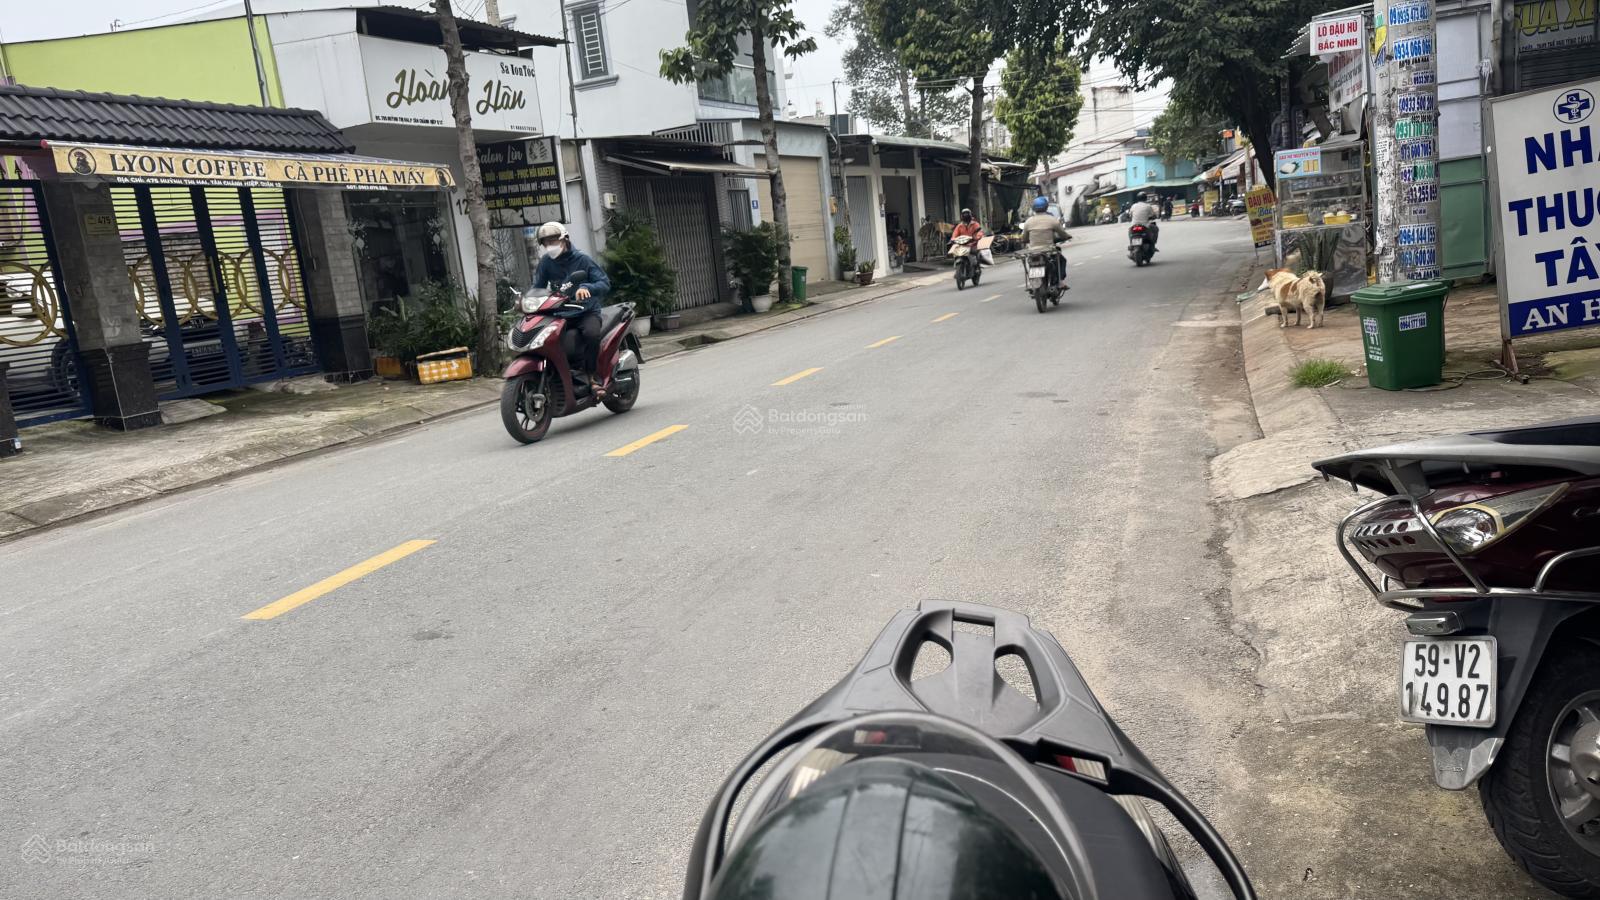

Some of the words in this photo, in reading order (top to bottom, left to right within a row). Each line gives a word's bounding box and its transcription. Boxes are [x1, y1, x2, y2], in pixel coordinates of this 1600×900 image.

[1337, 37, 1358, 48] NINH
[109, 153, 174, 175] LYON
[182, 158, 267, 178] COFFEE
[284, 161, 308, 181] CÀ
[312, 164, 350, 183] PHÊ
[354, 168, 389, 184] PHA
[393, 167, 425, 184] MÁY
[1525, 125, 1600, 175] NH
[1508, 187, 1600, 237] THU
[1535, 236, 1600, 288] TÂ
[1522, 303, 1570, 331] AN
[1415, 643, 1481, 679] 59-V2
[1405, 681, 1489, 720] 149.87
